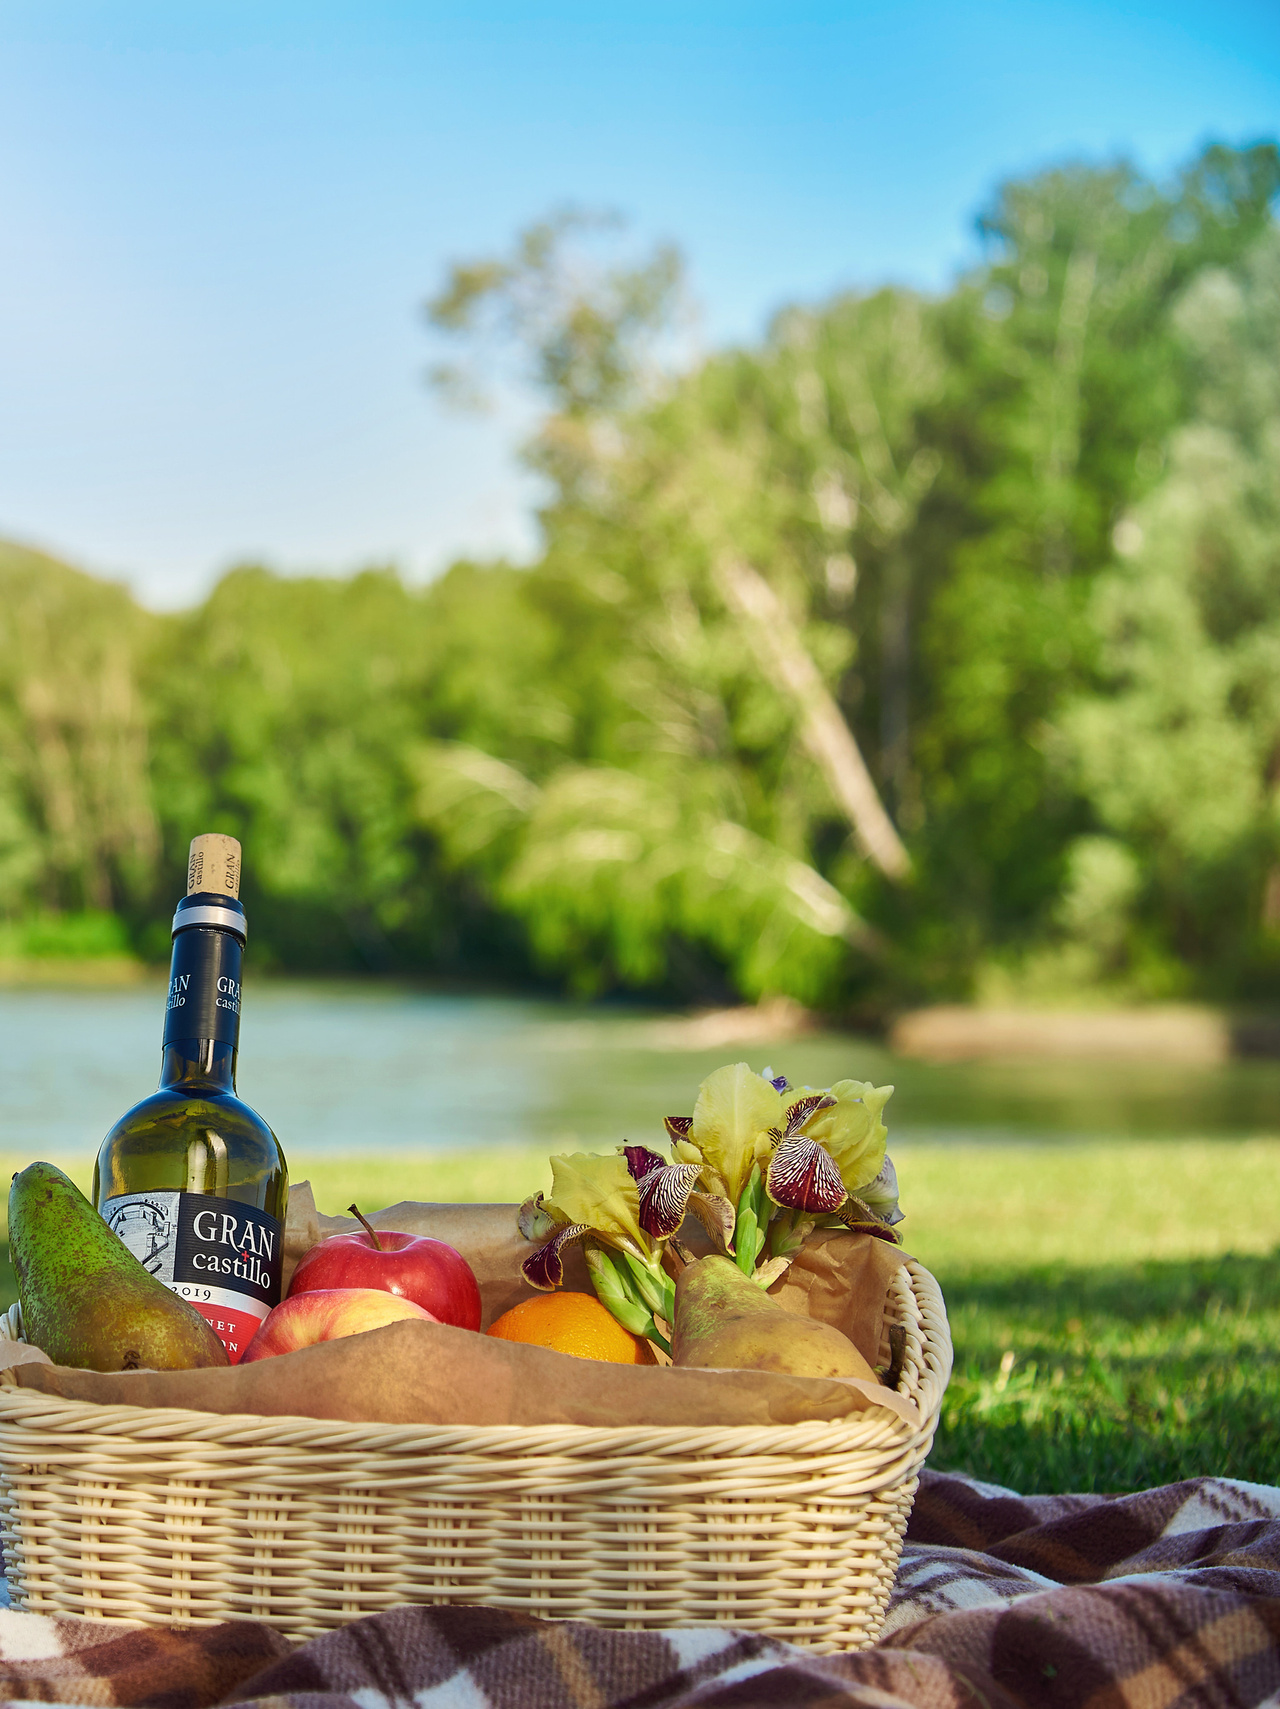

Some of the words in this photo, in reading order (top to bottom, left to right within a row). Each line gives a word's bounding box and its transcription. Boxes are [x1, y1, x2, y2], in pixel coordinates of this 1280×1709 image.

[196, 851, 204, 886] castillo
[225, 853, 236, 890] GRAN
[193, 1210, 275, 1262] GRAN
[192, 1252, 271, 1289] castillo
[171, 1286, 212, 1301] 2019
